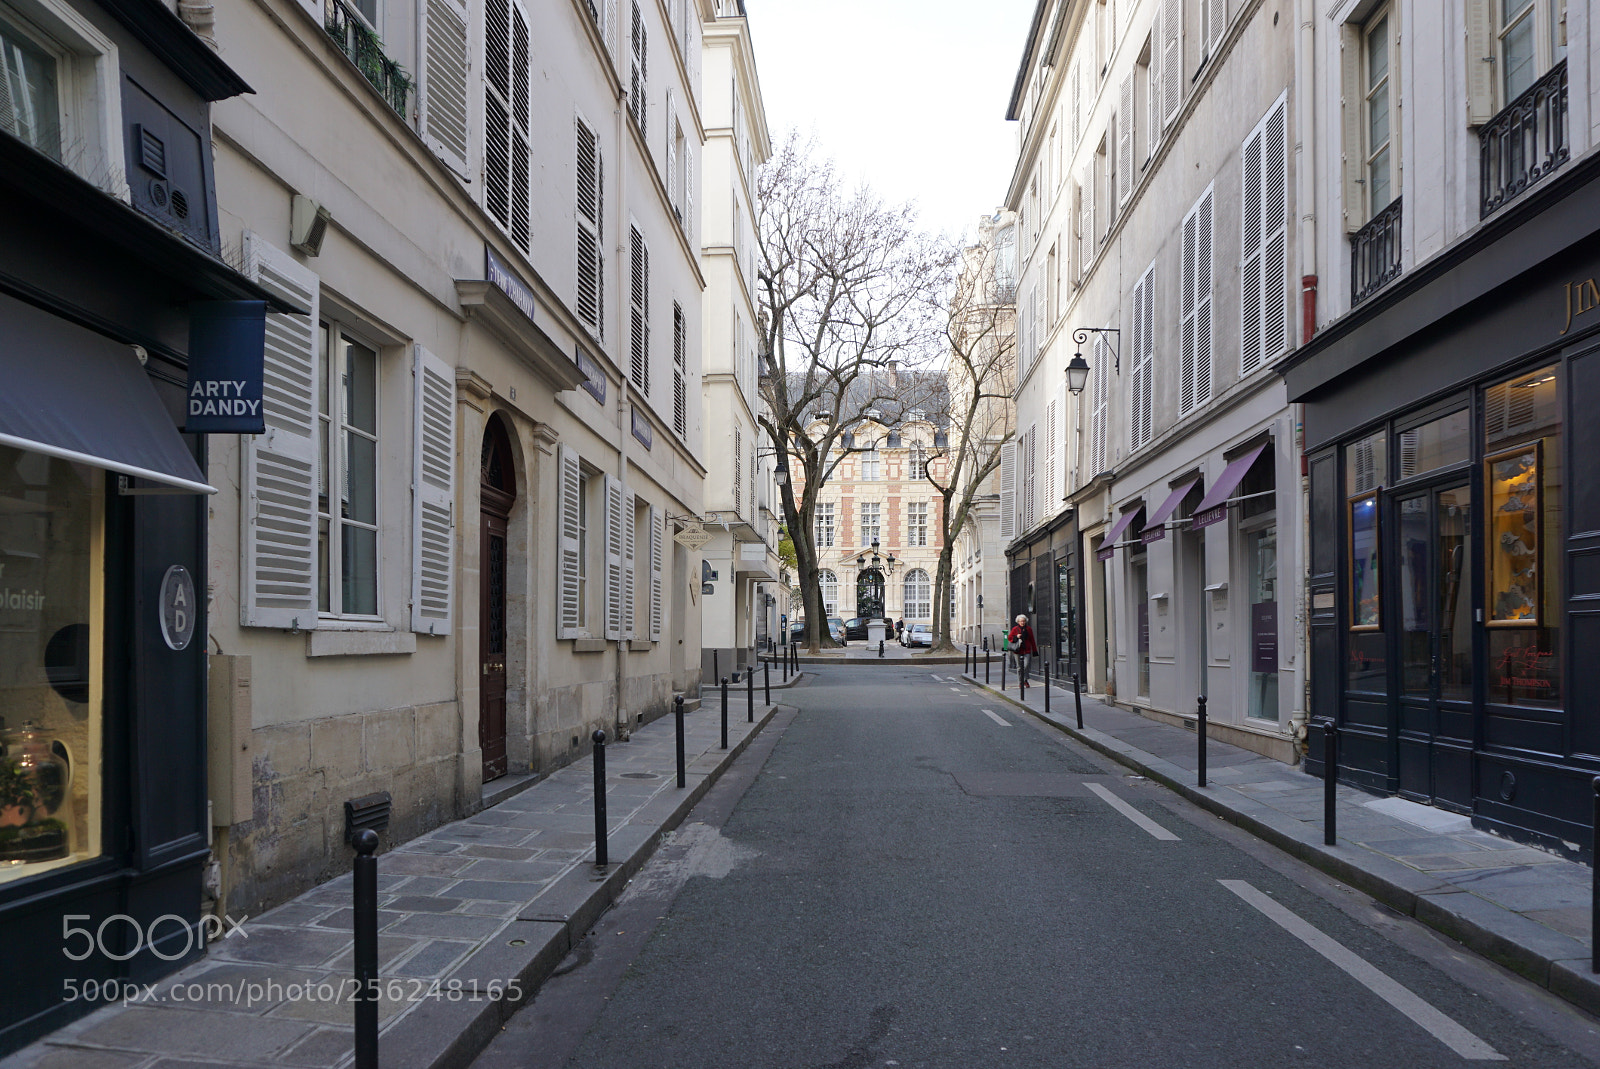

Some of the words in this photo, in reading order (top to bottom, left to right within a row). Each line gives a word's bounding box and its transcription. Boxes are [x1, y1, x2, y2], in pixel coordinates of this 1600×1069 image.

[190, 380, 248, 397] ARTY
[189, 399, 261, 416] DANDY
[1511, 676, 1552, 688] THOMPSON
